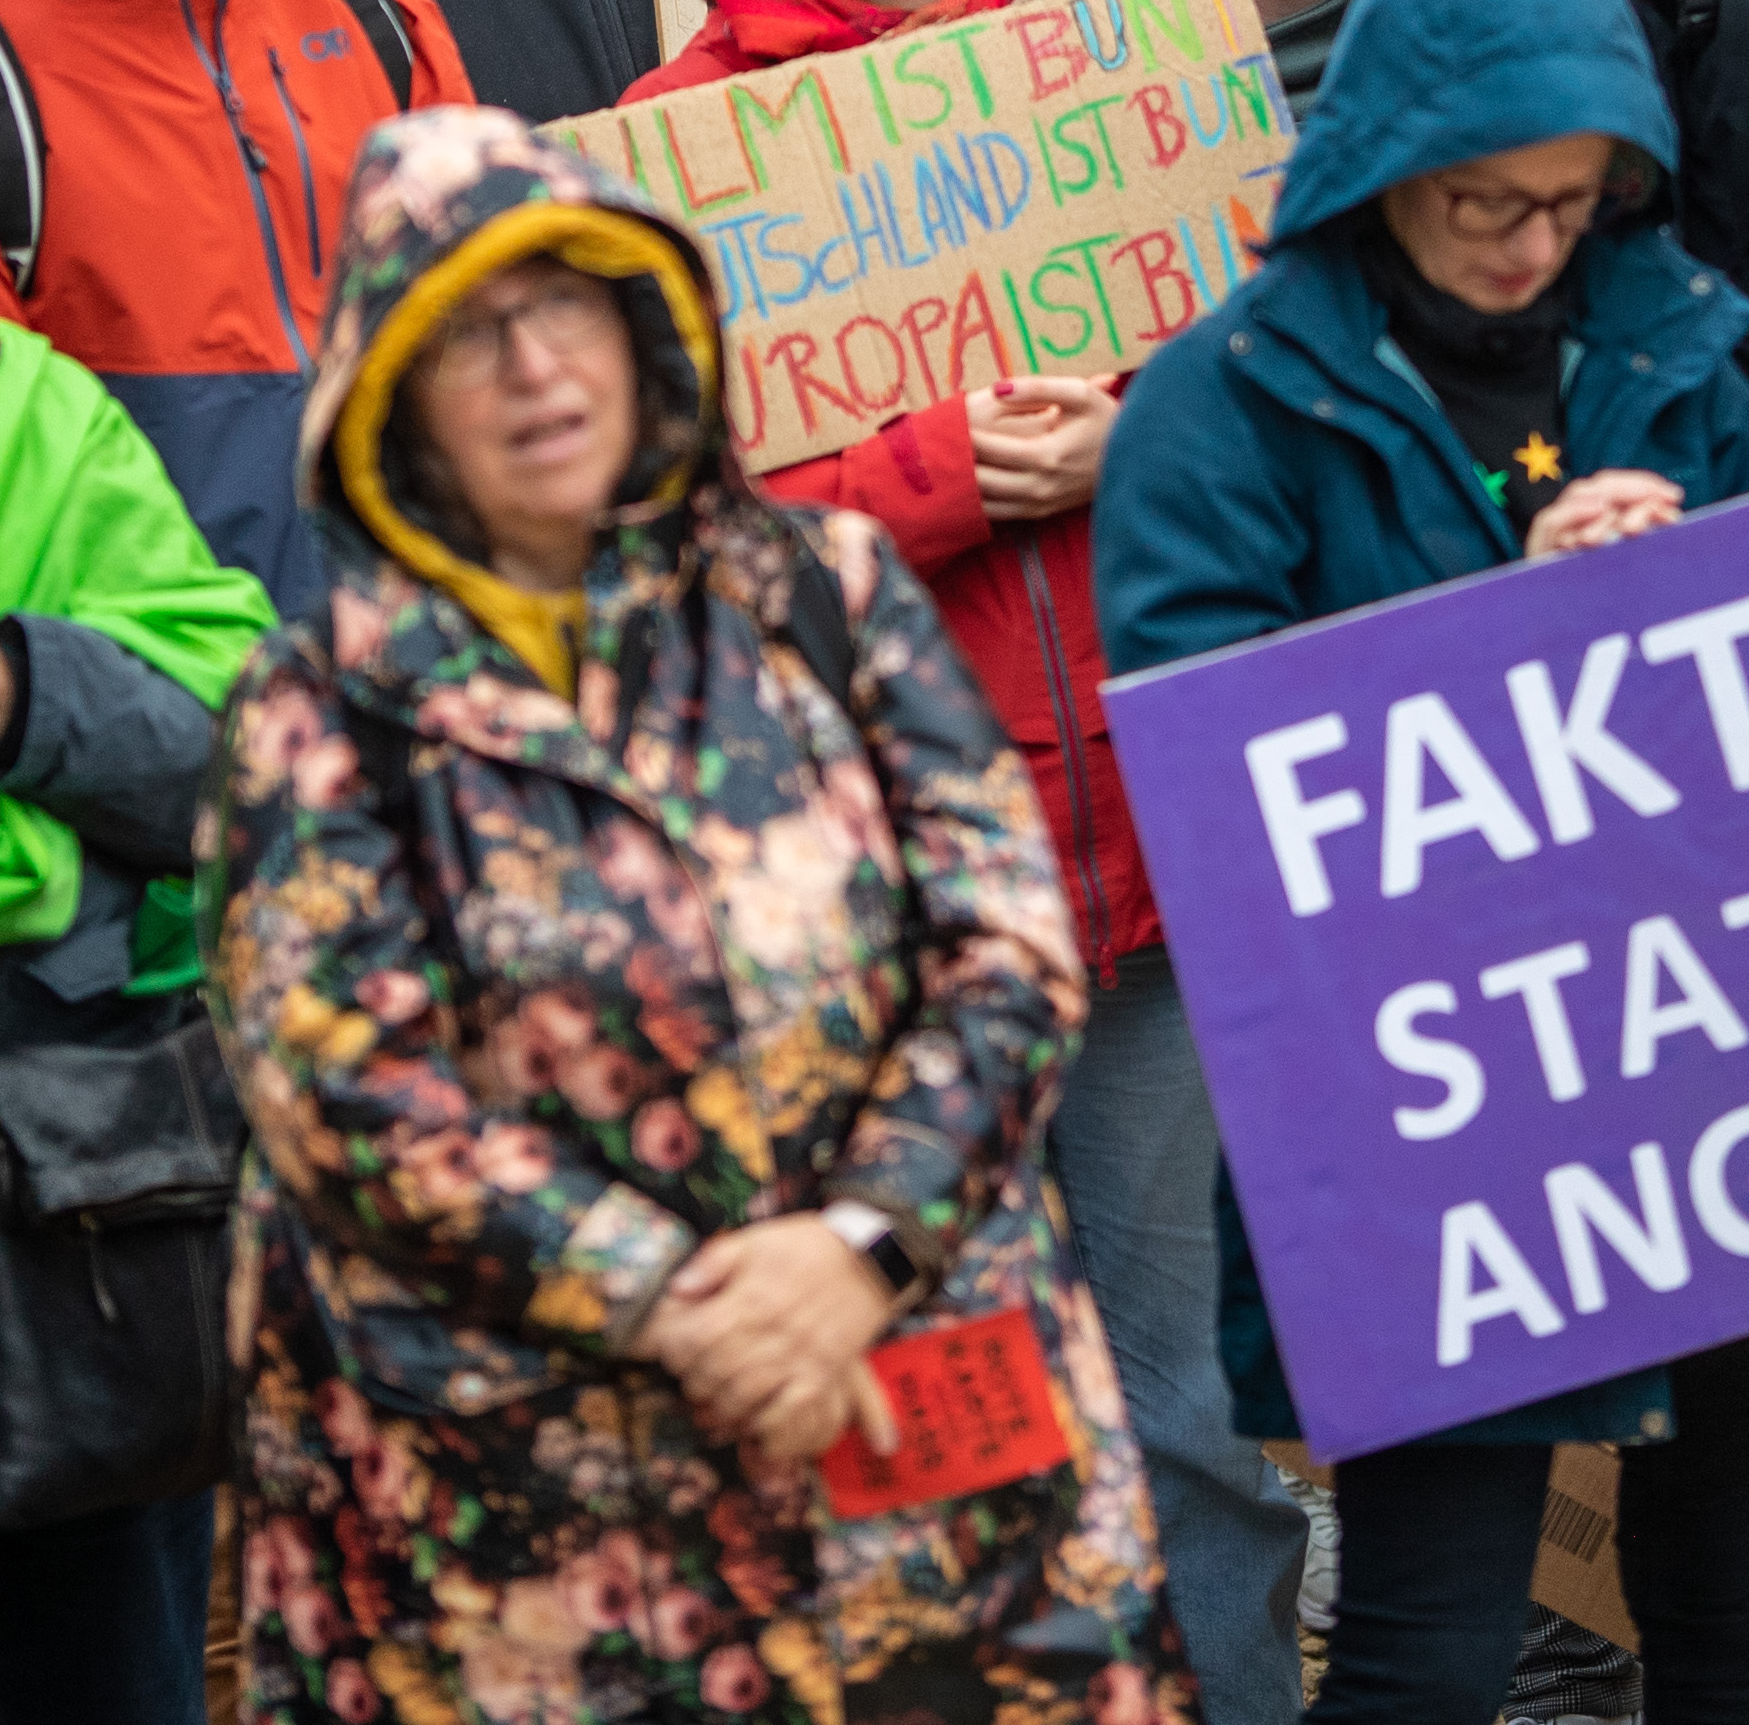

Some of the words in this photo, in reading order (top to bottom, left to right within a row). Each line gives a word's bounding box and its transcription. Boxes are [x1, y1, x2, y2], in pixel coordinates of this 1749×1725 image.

[862, 21, 998, 146] IST
[1032, 94, 1126, 208] IST
[1126, 52, 1298, 169] BUNT
[728, 271, 1013, 455] UROPA
[1001, 232, 1125, 374] IST
